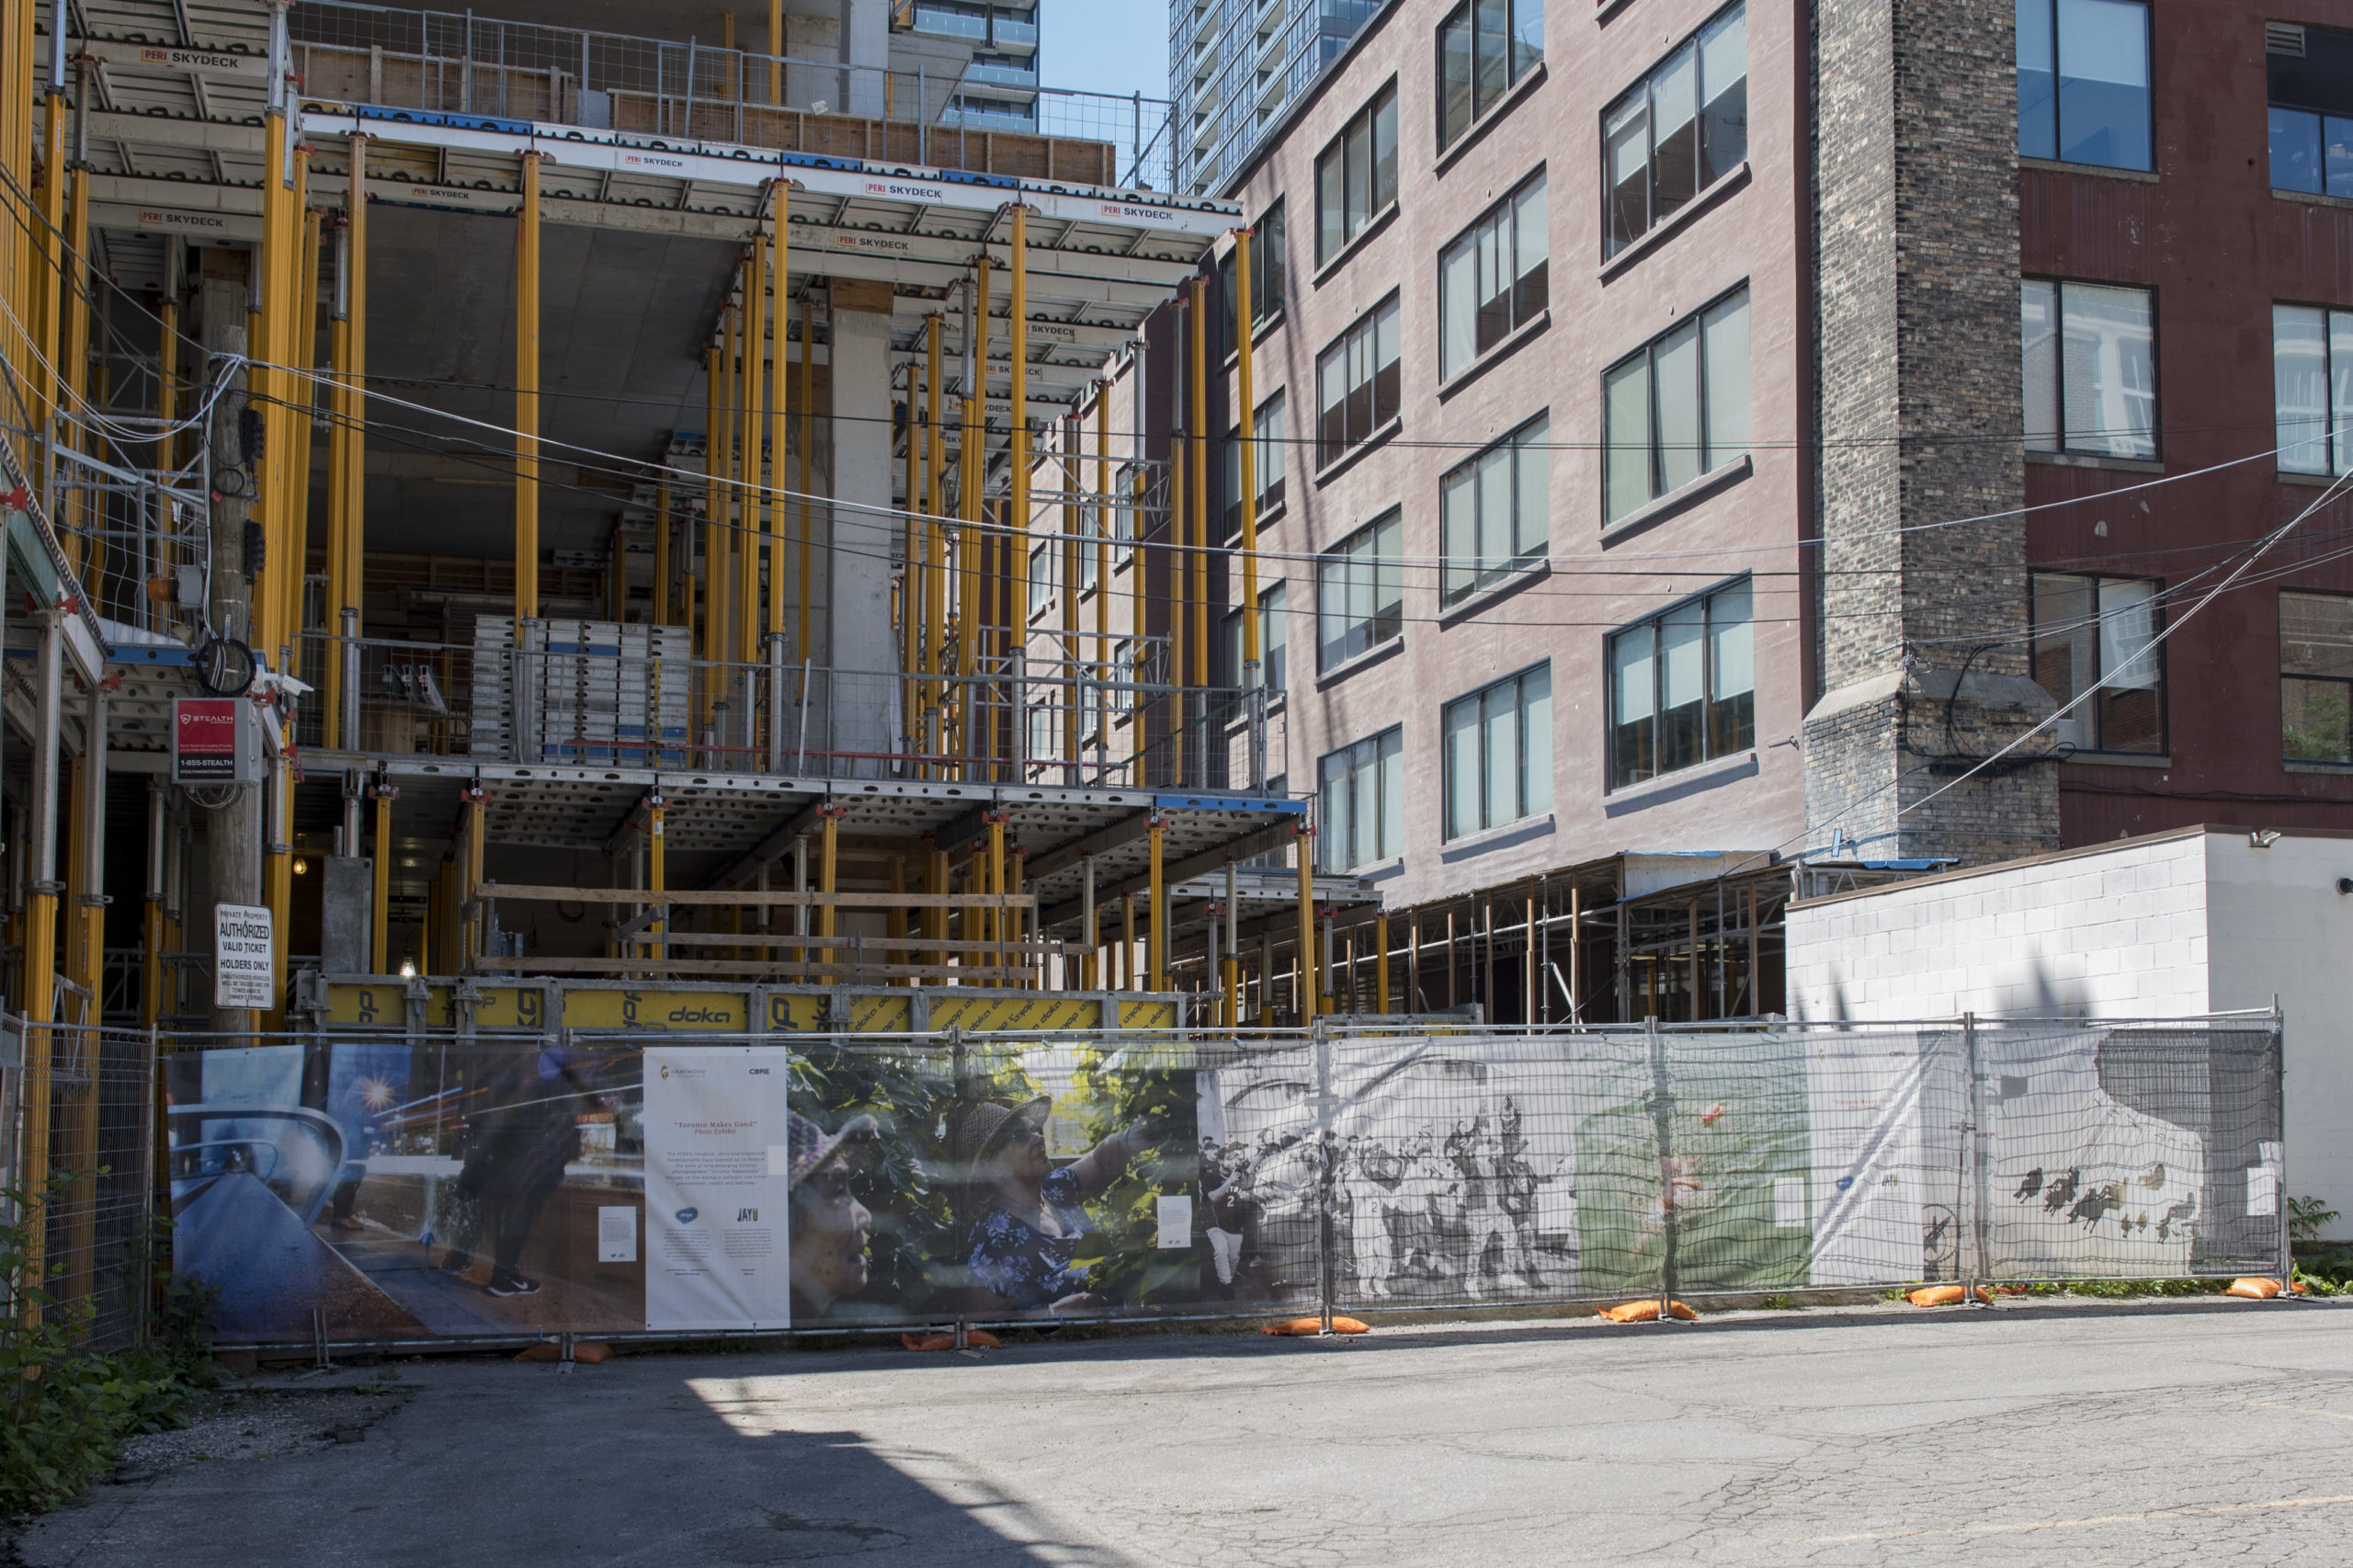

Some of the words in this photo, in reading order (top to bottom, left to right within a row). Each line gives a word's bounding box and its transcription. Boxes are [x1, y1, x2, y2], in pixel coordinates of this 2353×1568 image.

[145, 50, 167, 61] PERI
[172, 52, 239, 68] SKYDECK
[644, 157, 684, 167] SKYDECK
[430, 189, 469, 199] SKYDECK
[868, 183, 886, 193] PERI
[889, 186, 941, 199] SKYDECK
[143, 212, 162, 222] PERI
[166, 213, 223, 227] SKYDECK
[1103, 204, 1120, 215] PERI
[1123, 207, 1172, 222] SKYDECK
[839, 235, 857, 244] PERI
[860, 238, 908, 250] SKYDECK
[1031, 325, 1074, 336] SKYDECK
[220, 910, 241, 918] PRIVATE
[243, 911, 268, 920] PROPERTY
[220, 922, 269, 939] AUTHORIZED
[222, 941, 243, 951] VALID
[244, 942, 267, 953] TICKET
[221, 959, 251, 970] HOLDERS
[253, 961, 269, 971] ONLY
[668, 1006, 732, 1024] doka
[855, 1007, 878, 1032] doka
[1227, 1195, 1234, 1208] 2
[737, 1208, 758, 1221] JAYU
